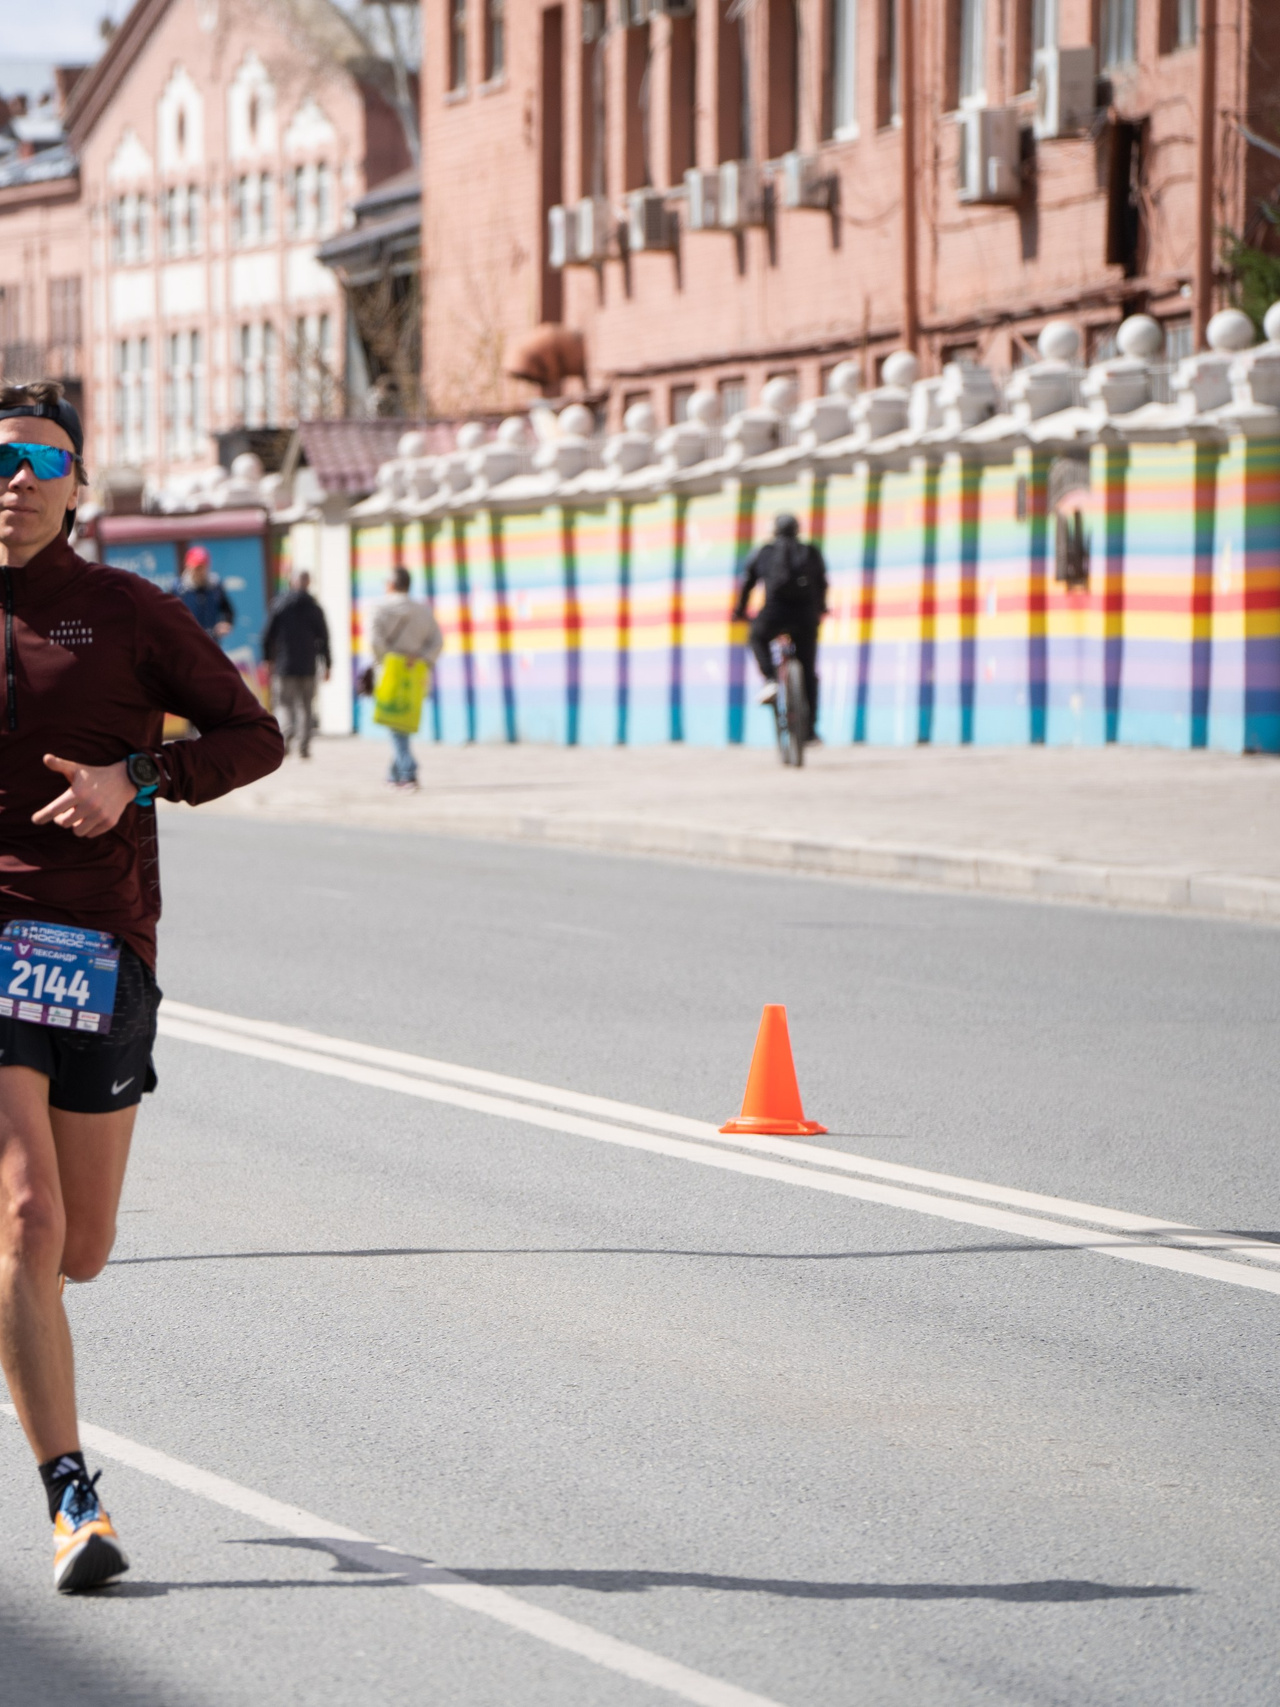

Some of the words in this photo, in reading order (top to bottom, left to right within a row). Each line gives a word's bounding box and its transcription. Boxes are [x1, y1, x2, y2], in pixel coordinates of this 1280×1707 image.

[28, 933, 84, 948] КОСМОС
[39, 927, 86, 941] ПРОСТО
[7, 960, 90, 1007] 2144
